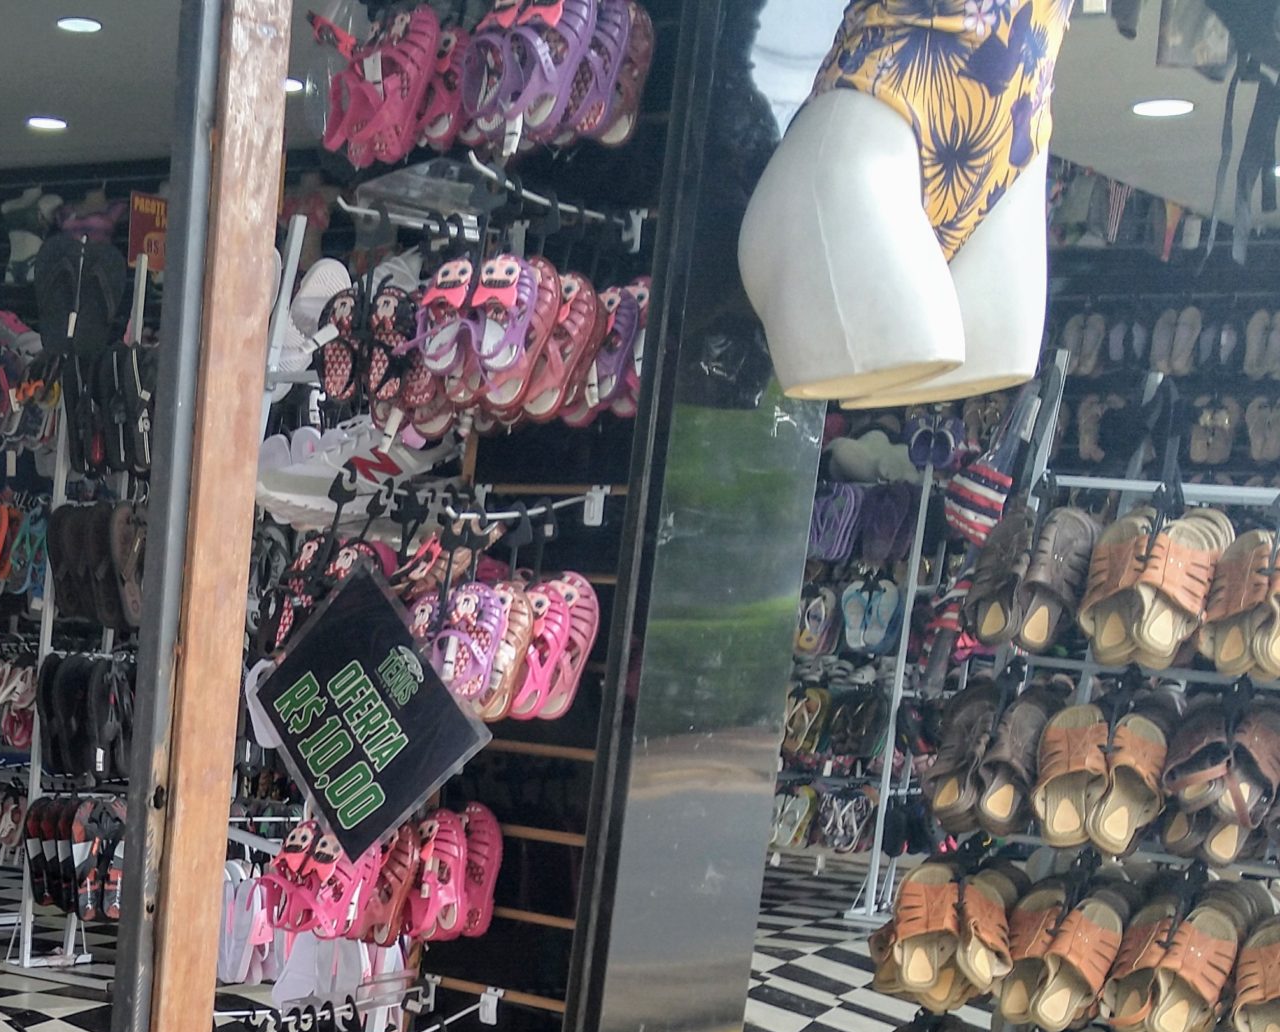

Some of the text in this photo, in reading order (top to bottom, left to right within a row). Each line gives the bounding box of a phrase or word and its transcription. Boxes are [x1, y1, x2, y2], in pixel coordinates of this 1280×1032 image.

[273, 671, 386, 830] R$ 10,00
[327, 660, 409, 772] OFERTA
